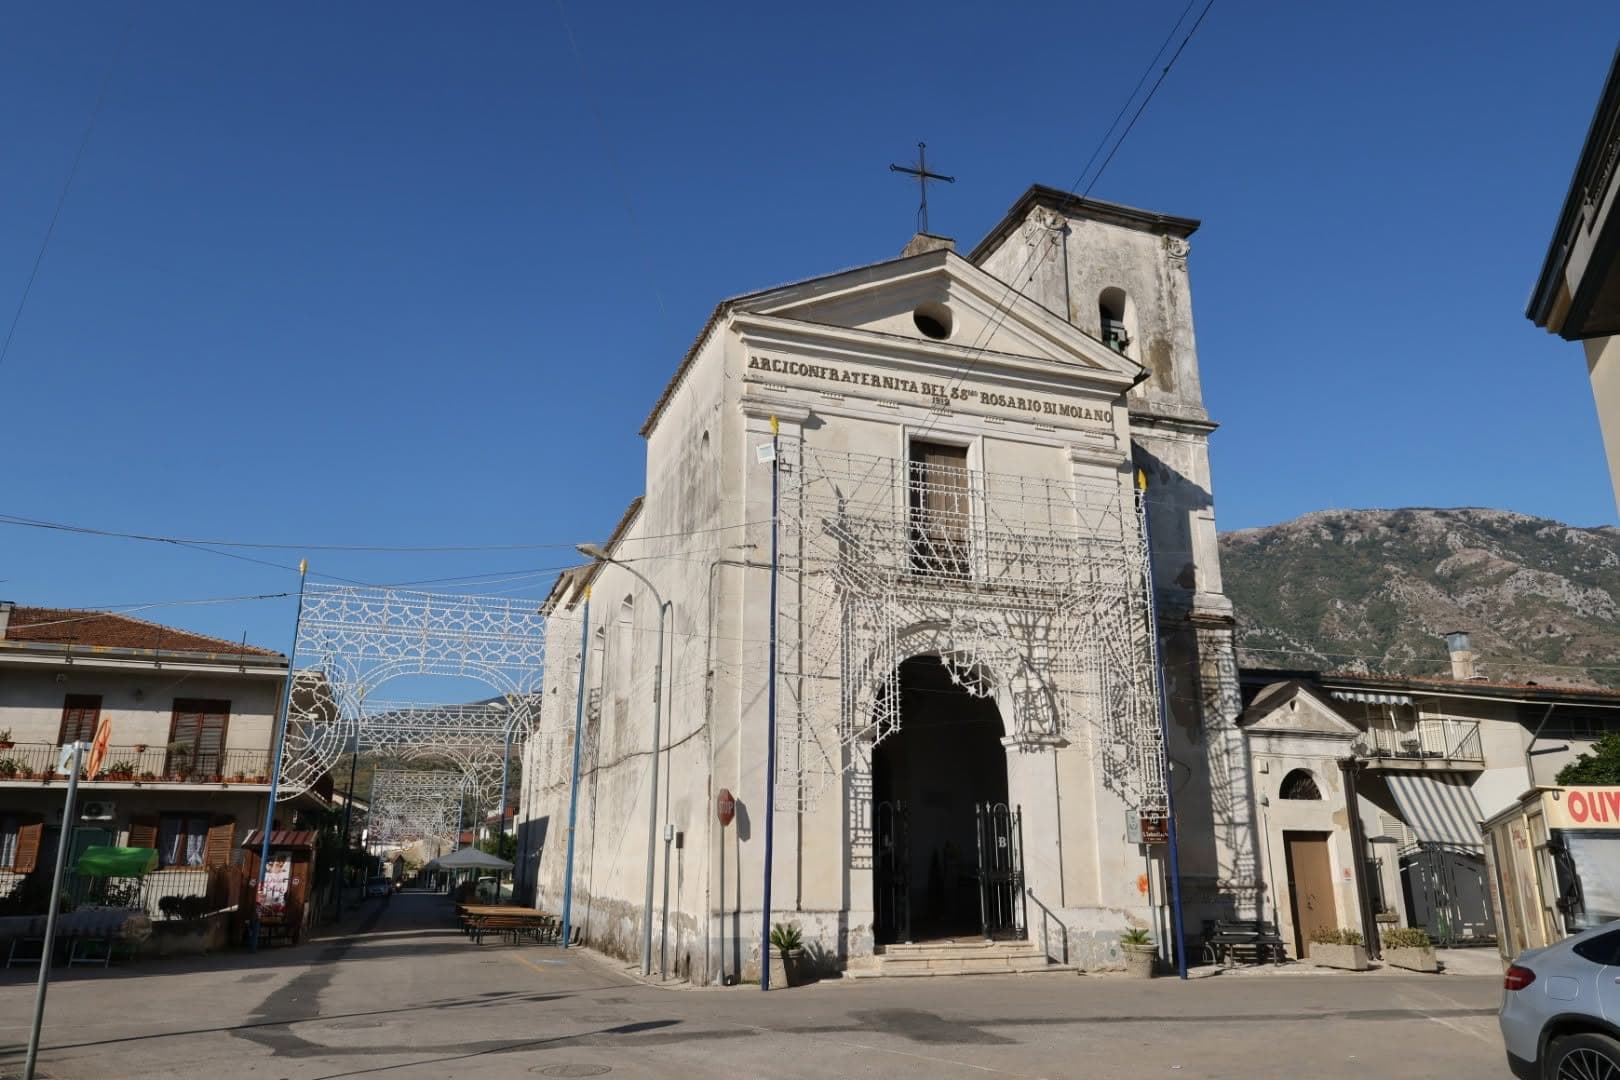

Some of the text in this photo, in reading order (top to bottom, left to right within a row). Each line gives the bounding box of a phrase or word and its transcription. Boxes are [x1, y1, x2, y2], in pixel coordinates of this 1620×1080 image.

[748, 356, 918, 393] ARCICONFRATERNITA
[921, 382, 948, 398] DEL
[980, 391, 1042, 412] ROSARIO
[1043, 402, 1057, 415] DI
[1059, 405, 1112, 423] MOIANO
